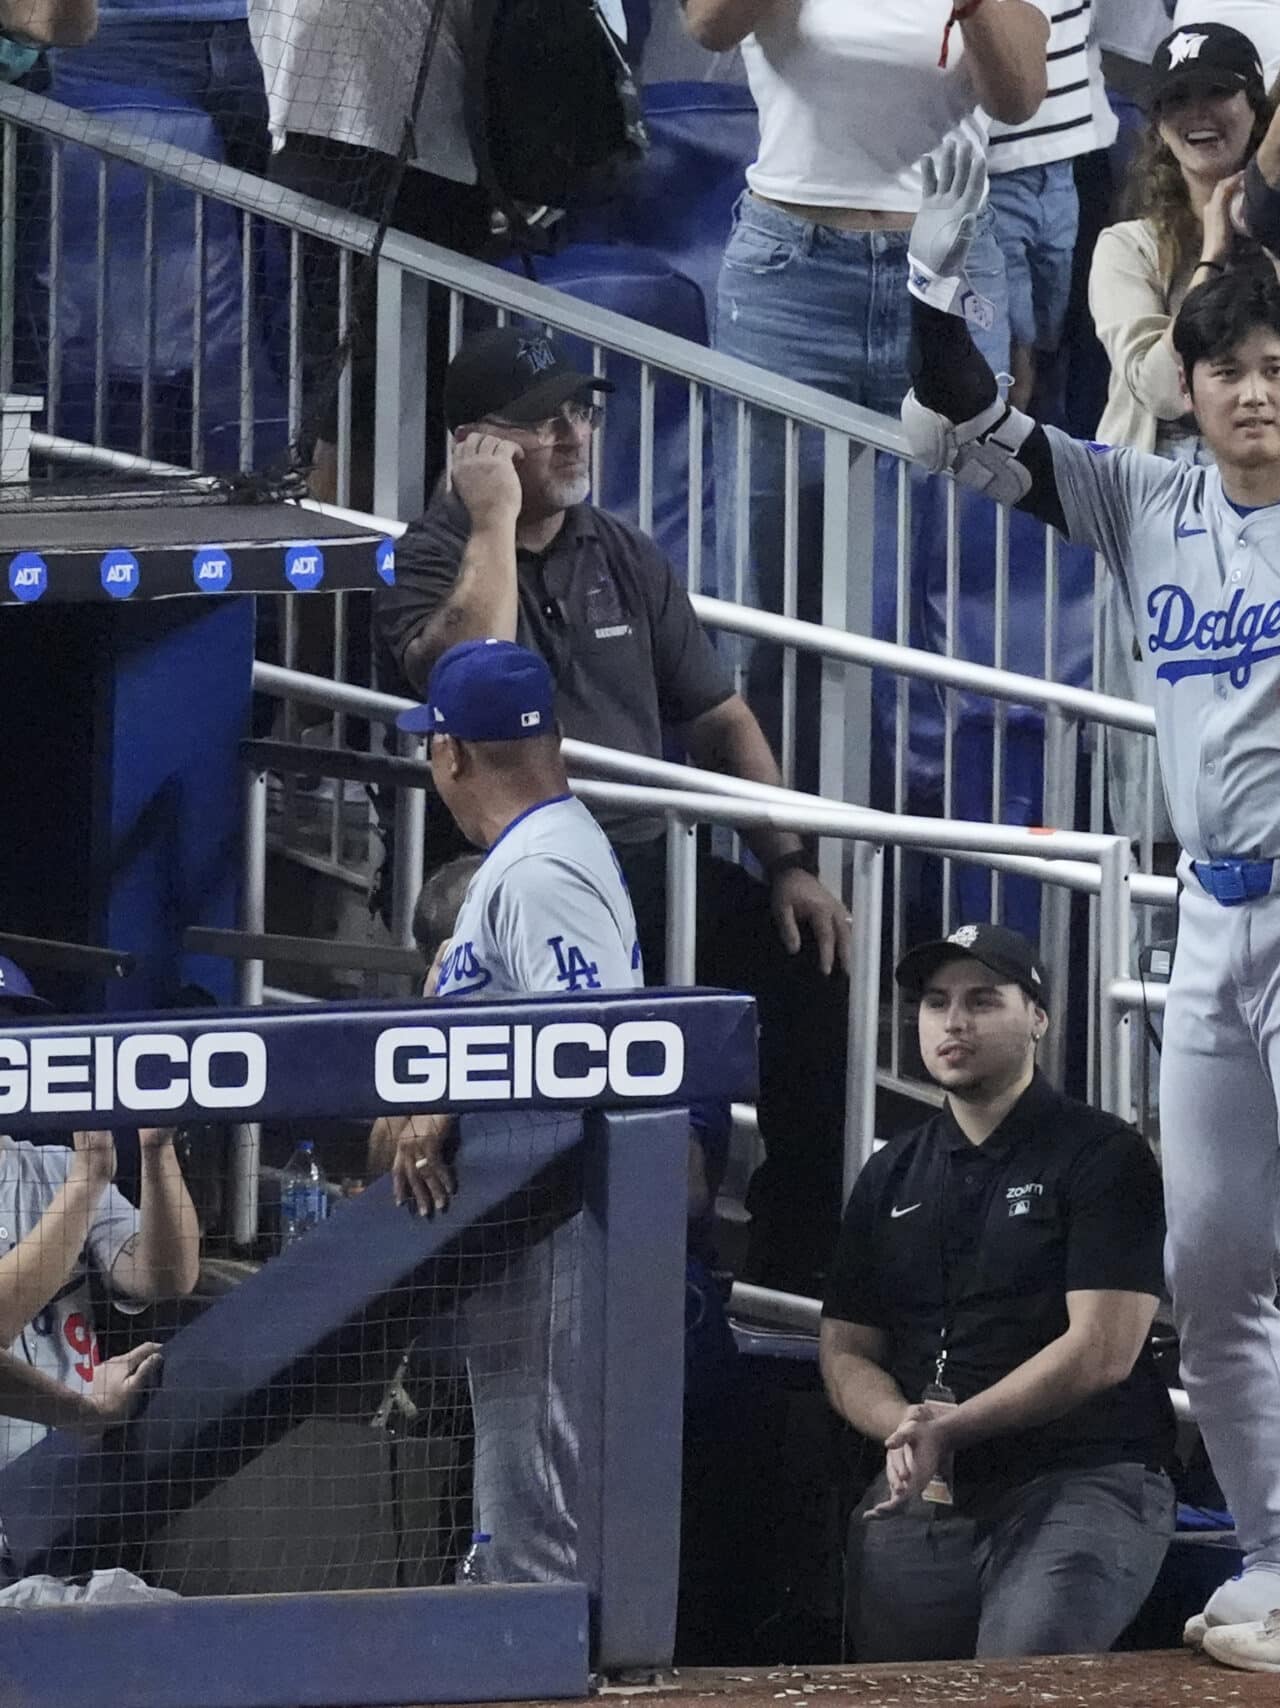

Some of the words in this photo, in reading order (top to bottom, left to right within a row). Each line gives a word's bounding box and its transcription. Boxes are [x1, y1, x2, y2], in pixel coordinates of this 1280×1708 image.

[106, 563, 135, 583] ADT
[199, 560, 227, 580] ADT
[290, 556, 318, 576] ADT
[14, 568, 42, 586] ADT
[547, 936, 601, 991] LA
[375, 1020, 684, 1103] GEICO
[1005, 1182, 1044, 1199] zoom
